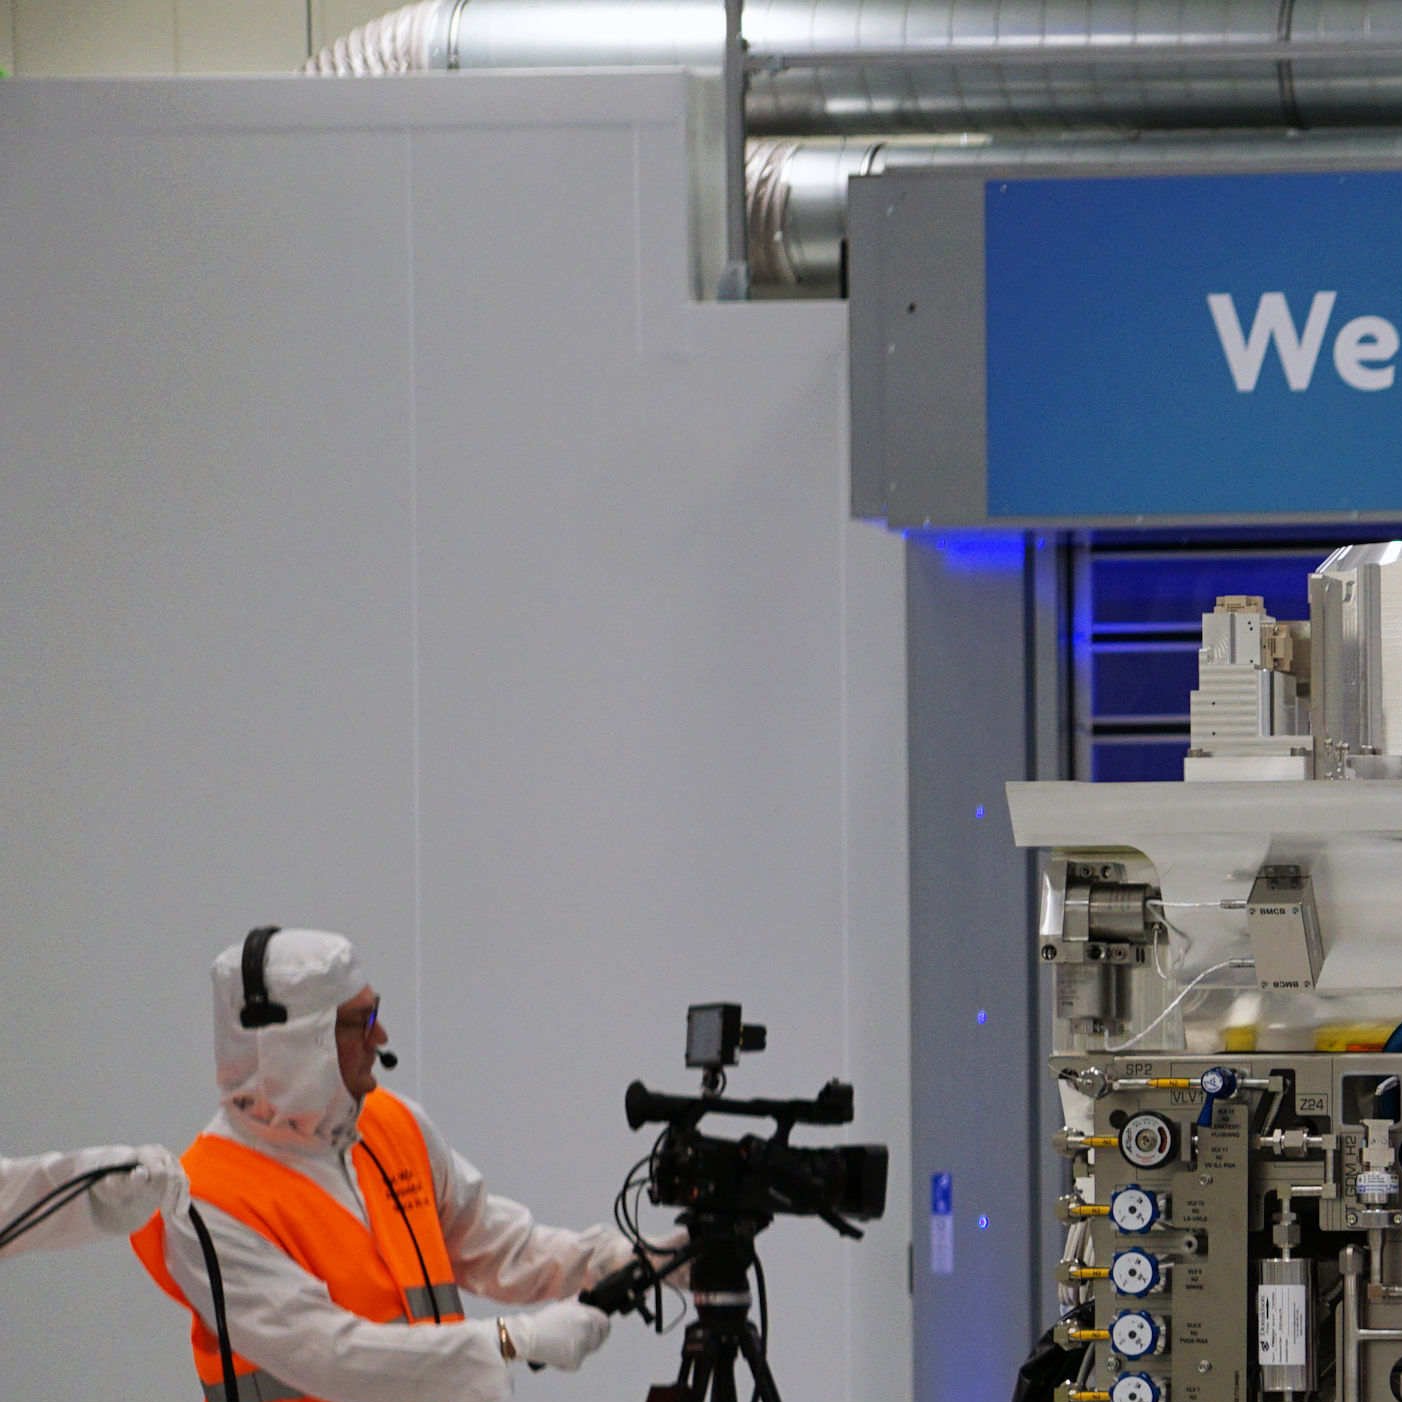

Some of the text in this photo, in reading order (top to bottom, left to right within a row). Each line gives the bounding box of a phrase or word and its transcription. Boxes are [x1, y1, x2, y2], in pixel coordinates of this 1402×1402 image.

[1126, 1064, 1152, 1076] SP2
[1172, 1091, 1205, 1103] VLV1
[1300, 1099, 1324, 1111] Z24
